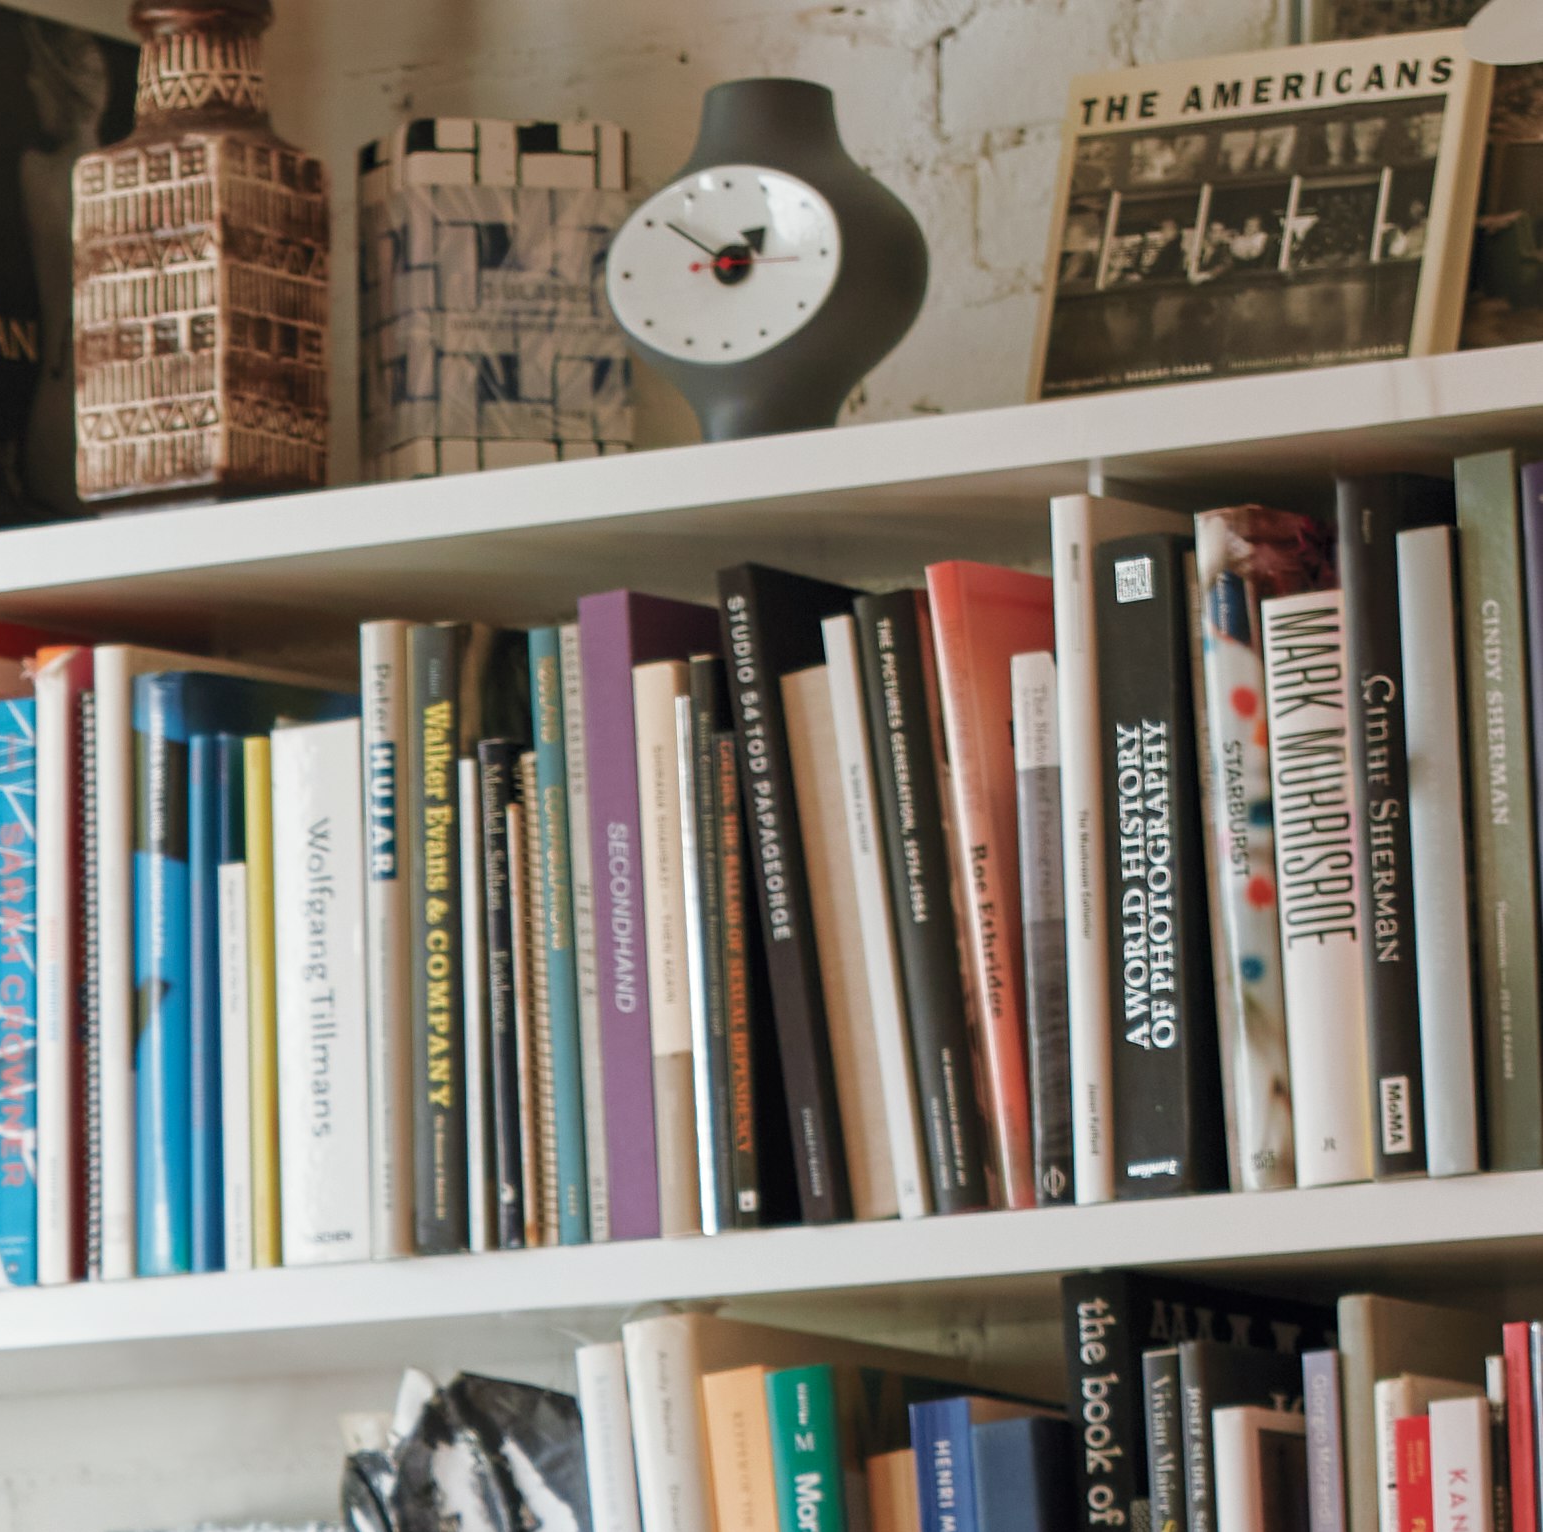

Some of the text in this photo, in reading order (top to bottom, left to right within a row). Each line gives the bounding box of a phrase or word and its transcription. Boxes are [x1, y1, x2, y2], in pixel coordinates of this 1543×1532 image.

[1081, 56, 1454, 125] THE AMERICANS
[876, 618, 895, 648] THE
[880, 651, 908, 730] PICTURES
[370, 662, 395, 880] Peter HUJAR
[726, 595, 793, 941] STUDIO 54 TOD PAPAGEORGE
[1268, 607, 1360, 949] MARK MORRISROE
[1481, 600, 1510, 826] CINDY SHERMAN
[888, 733, 917, 835] GENERATION,
[1222, 740, 1250, 879] STARBURST
[423, 700, 454, 1108] Walker Evans & COMPANY
[607, 822, 636, 1014] SECONDHAND
[968, 842, 1007, 1021] Roe Ethridge
[1116, 724, 1150, 1049] A WORLD HISTORY
[1144, 720, 1176, 1048] OF PHOTOGRAPHY
[301, 818, 338, 1138] Wolfgang Tillmans
[0, 974, 28, 1187] CROWNER
[1384, 1084, 1406, 1147] MoMA
[1077, 1297, 1116, 1365] the
[935, 1439, 958, 1509] HENRI
[1082, 1376, 1123, 1473] book
[1150, 1374, 1174, 1446] Vivian
[1089, 1484, 1124, 1527] of
[1156, 1452, 1178, 1514] Maier
